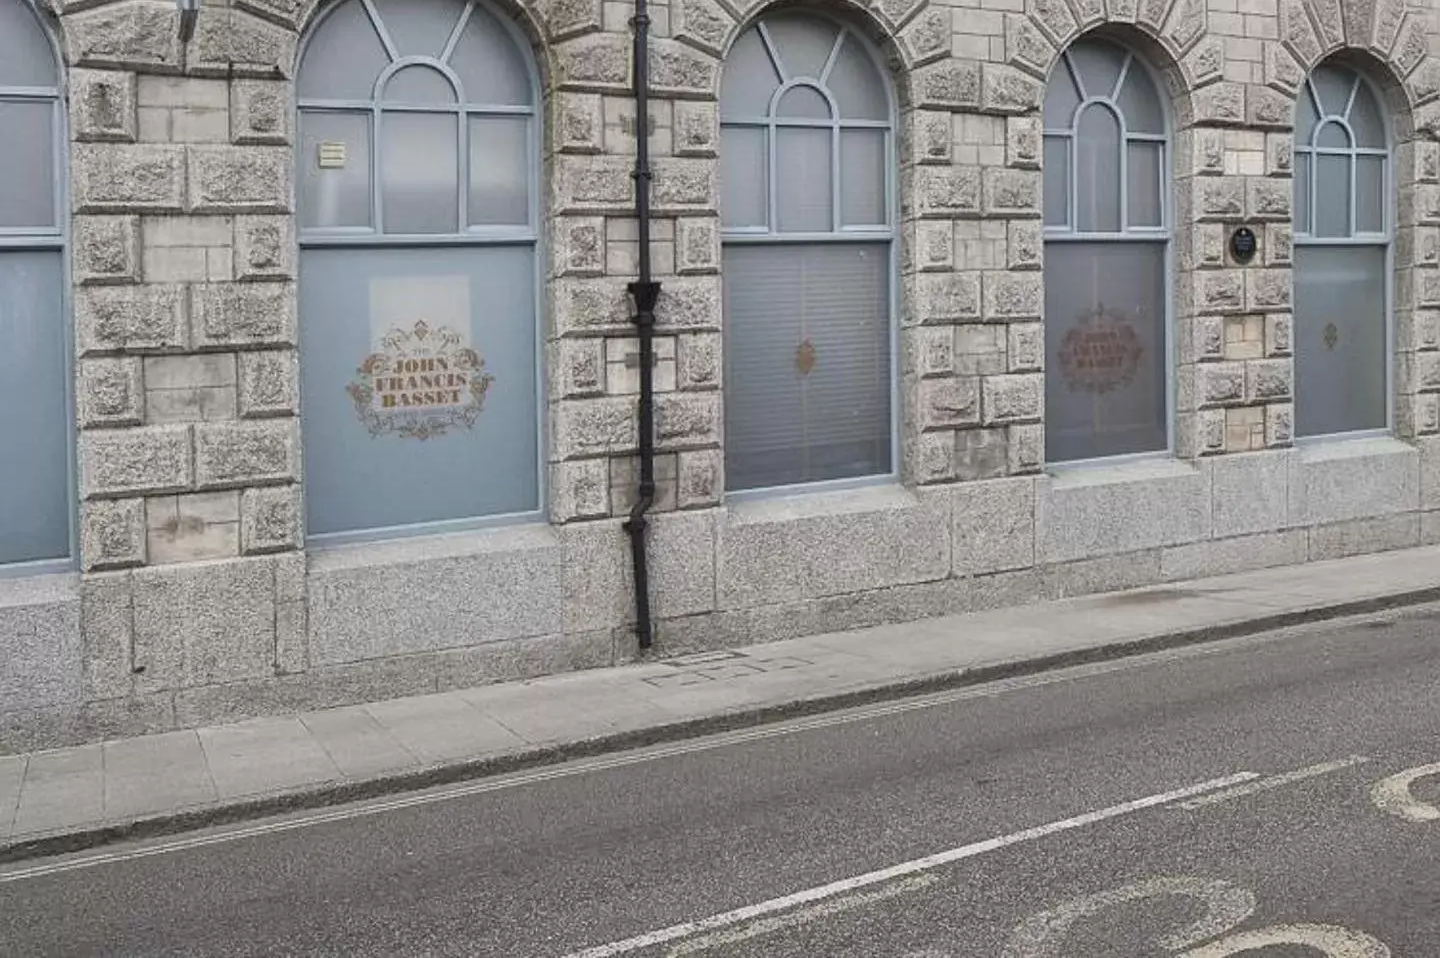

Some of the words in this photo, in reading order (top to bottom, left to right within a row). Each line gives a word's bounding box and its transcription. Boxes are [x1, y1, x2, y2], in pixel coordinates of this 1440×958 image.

[393, 357, 449, 375] JOHN
[375, 373, 467, 392] FRANCIS
[381, 389, 461, 408] BASSET
